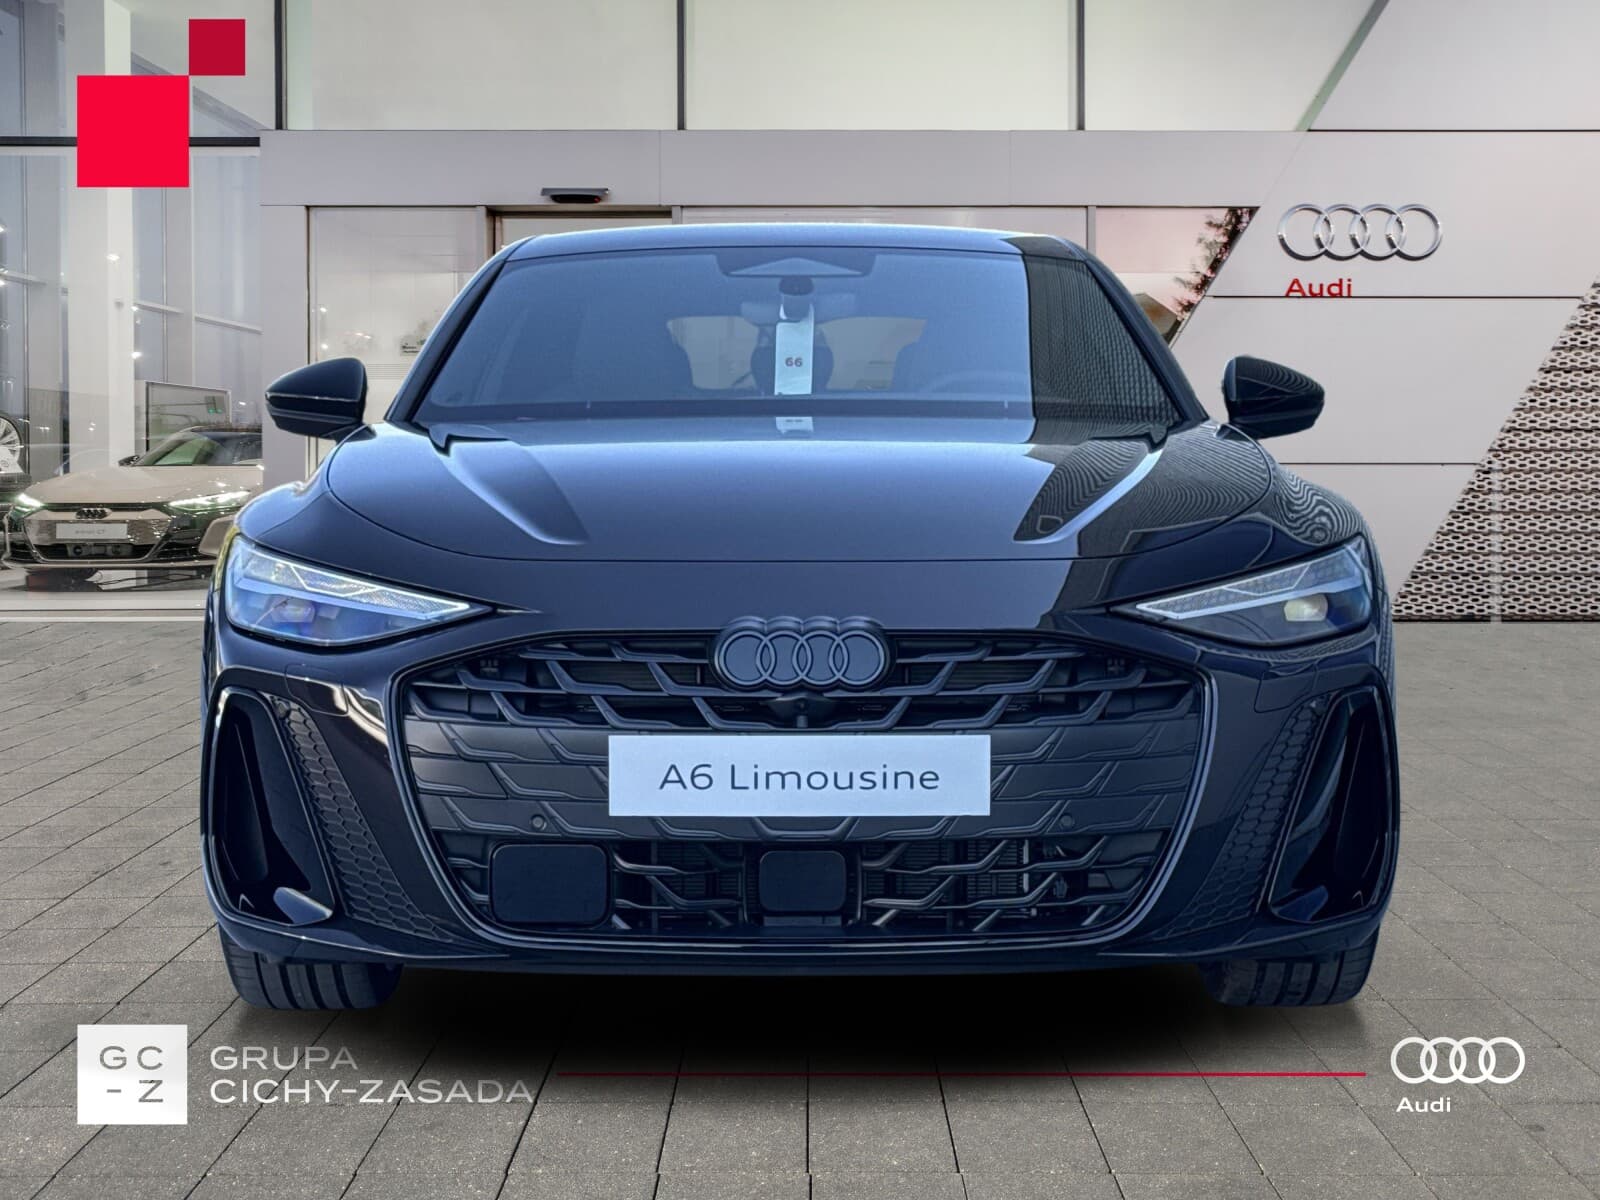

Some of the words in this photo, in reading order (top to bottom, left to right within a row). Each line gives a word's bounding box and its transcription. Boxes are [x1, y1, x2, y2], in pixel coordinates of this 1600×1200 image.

[1285, 278, 1352, 298] Audi
[785, 357, 803, 367] 66
[659, 764, 714, 790] A6
[730, 764, 940, 790] Limousine
